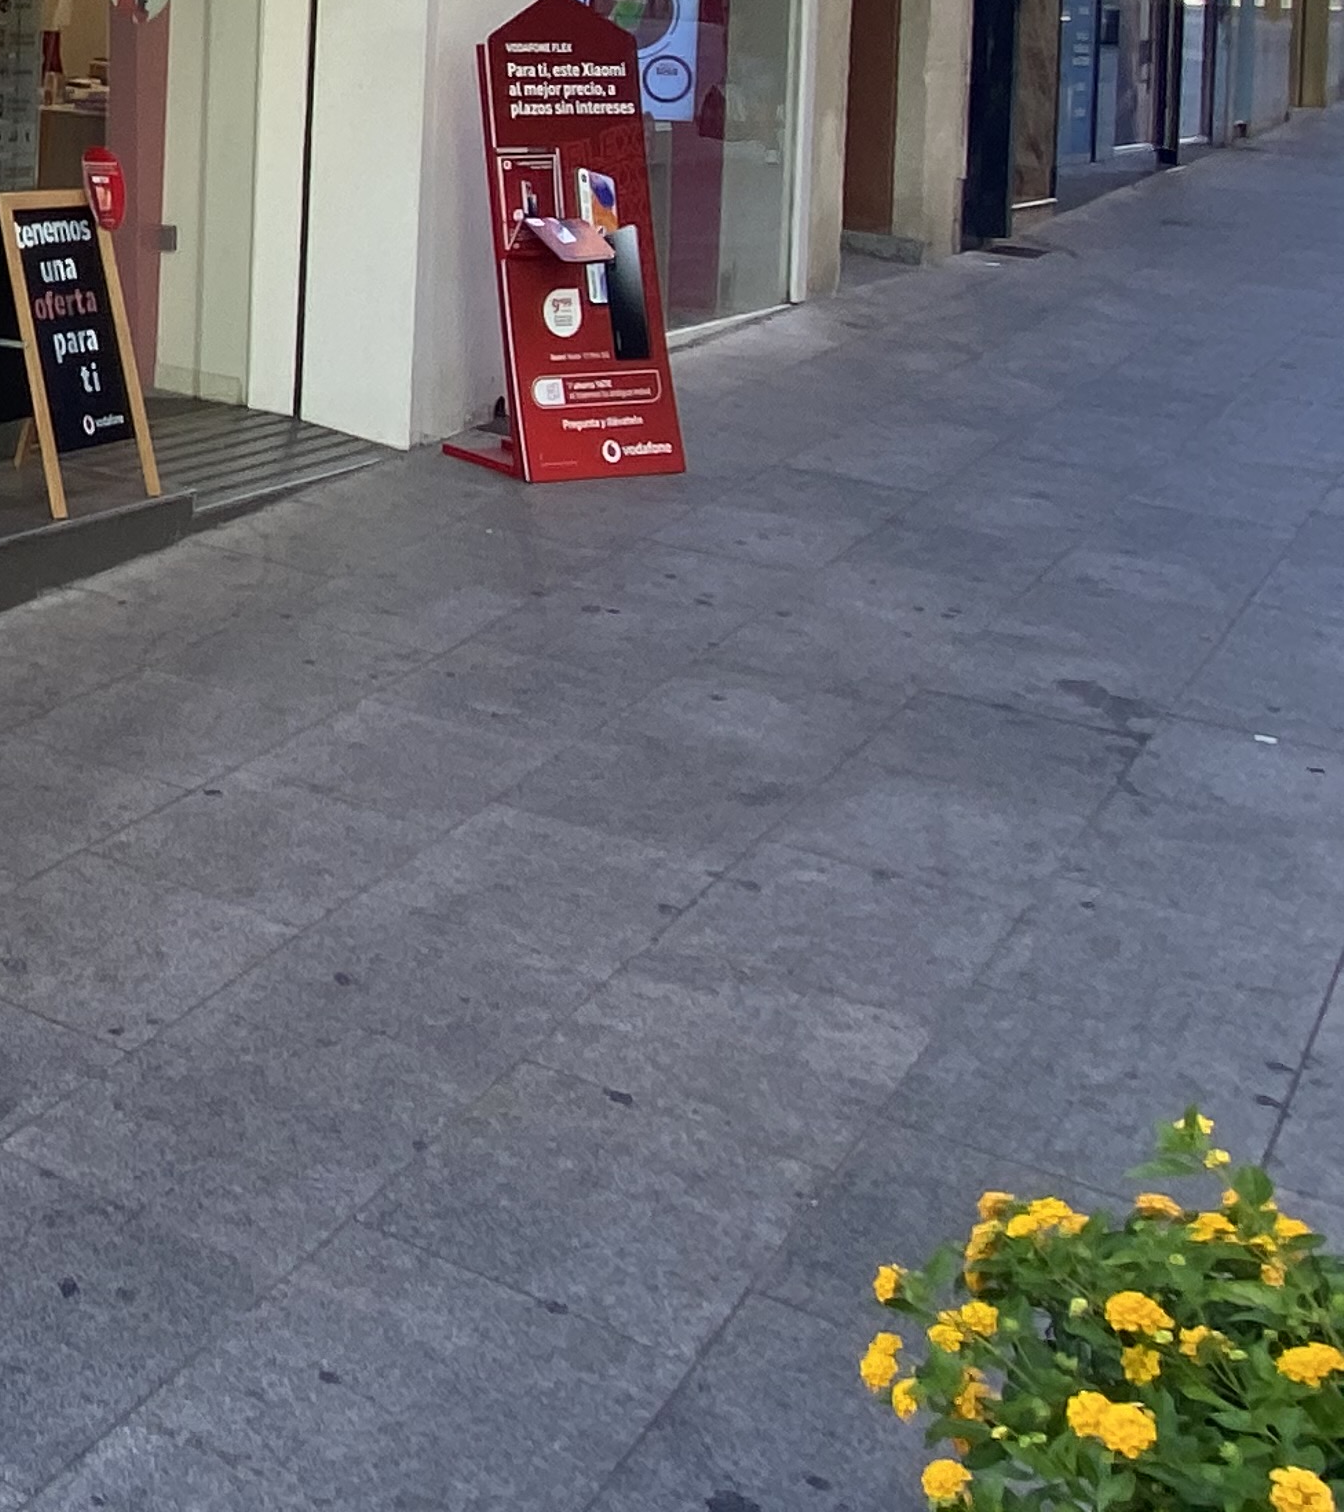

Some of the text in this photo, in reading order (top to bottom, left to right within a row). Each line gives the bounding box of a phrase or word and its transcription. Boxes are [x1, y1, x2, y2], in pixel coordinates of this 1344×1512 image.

[552, 43, 572, 52] FLEX
[507, 62, 626, 79] Para ti, este Xiaomi
[509, 81, 616, 99] al mejor precio, a
[511, 100, 635, 119] plazos sin intereses
[15, 219, 91, 249] tenemos
[40, 257, 77, 283] una
[35, 289, 97, 320] oferta
[53, 329, 99, 364] para
[80, 361, 101, 393] ti
[622, 441, 672, 456] vodafone
